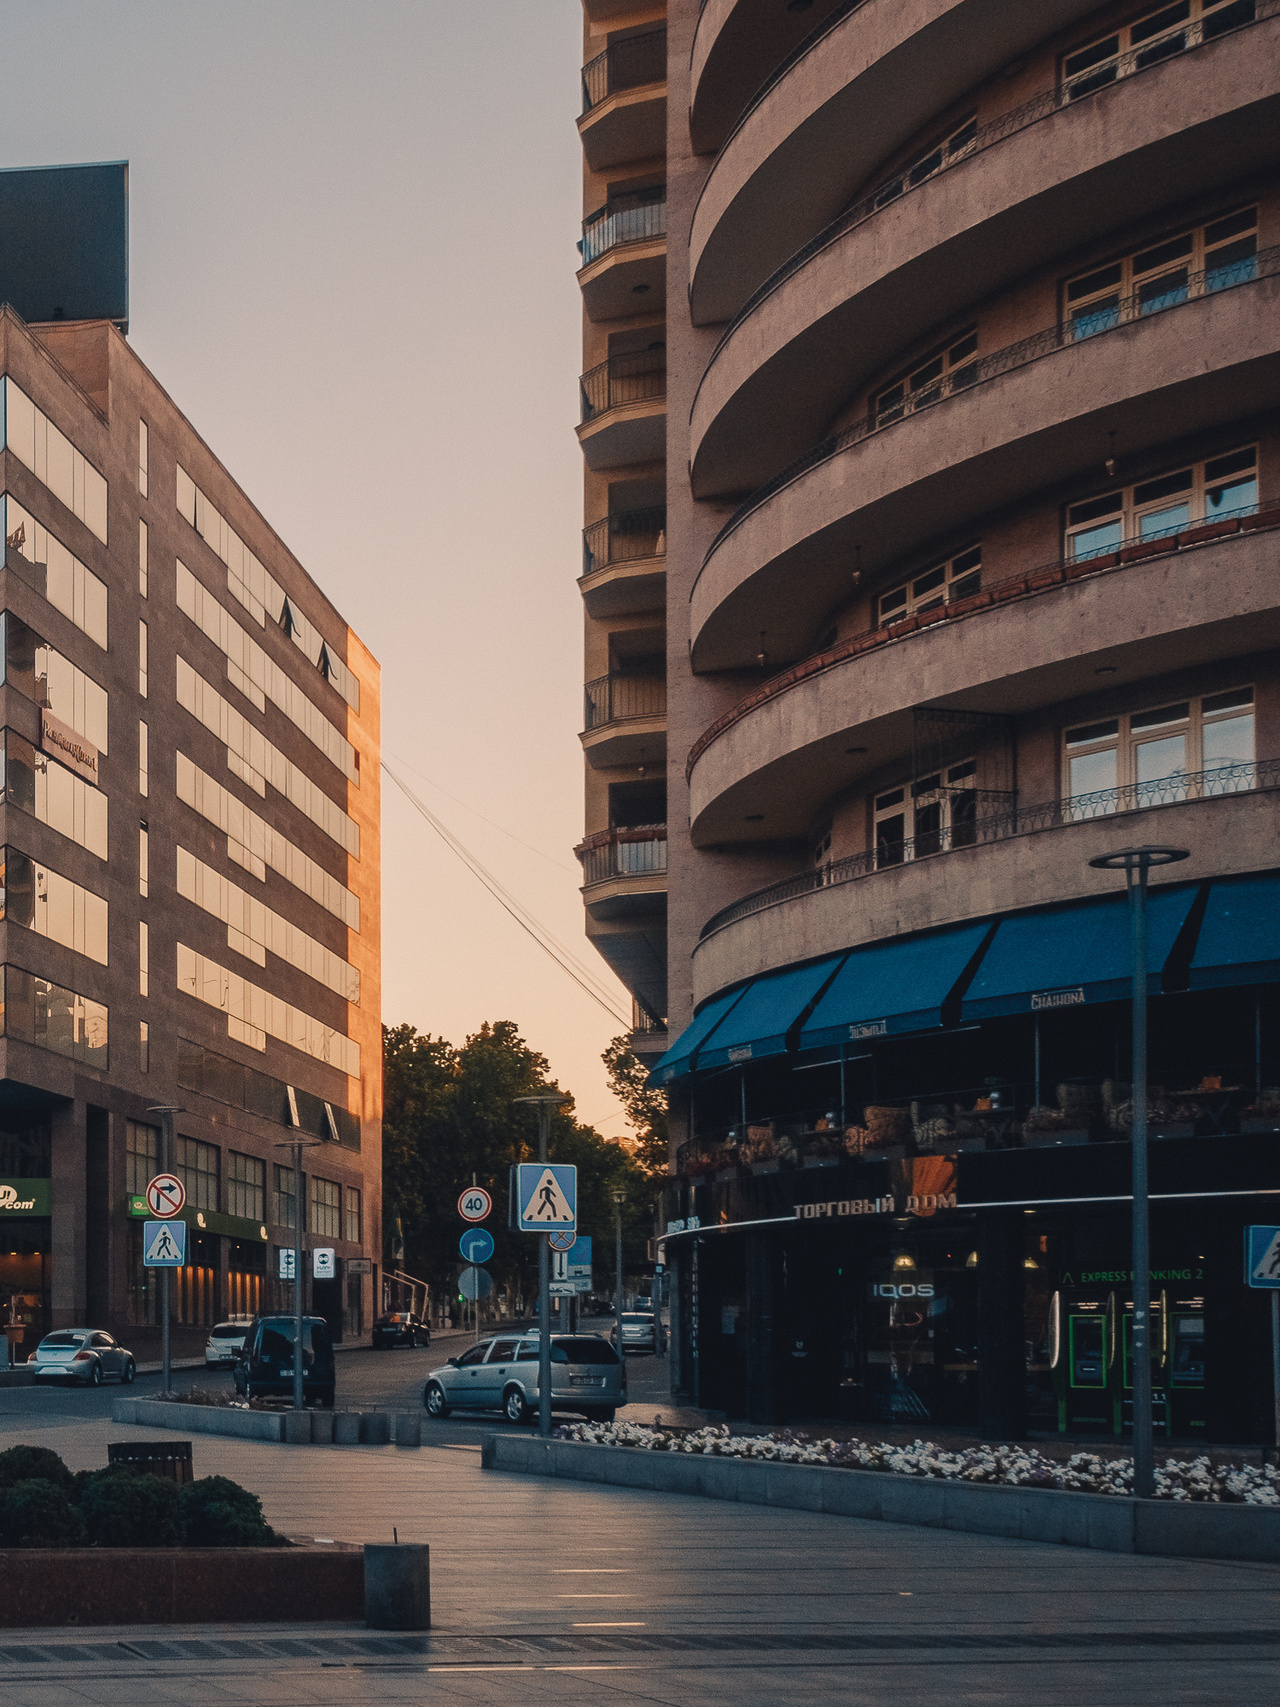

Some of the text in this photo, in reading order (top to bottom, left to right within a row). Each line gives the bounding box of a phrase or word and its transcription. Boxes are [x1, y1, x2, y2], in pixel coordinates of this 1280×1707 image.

[5, 1201, 34, 1210] com
[465, 1197, 483, 1211] 40
[793, 1193, 957, 1219] ТОРГОВЫЙ ДОМ
[1081, 1270, 1127, 1283] EXPRESS
[873, 1284, 935, 1299] IQOS
